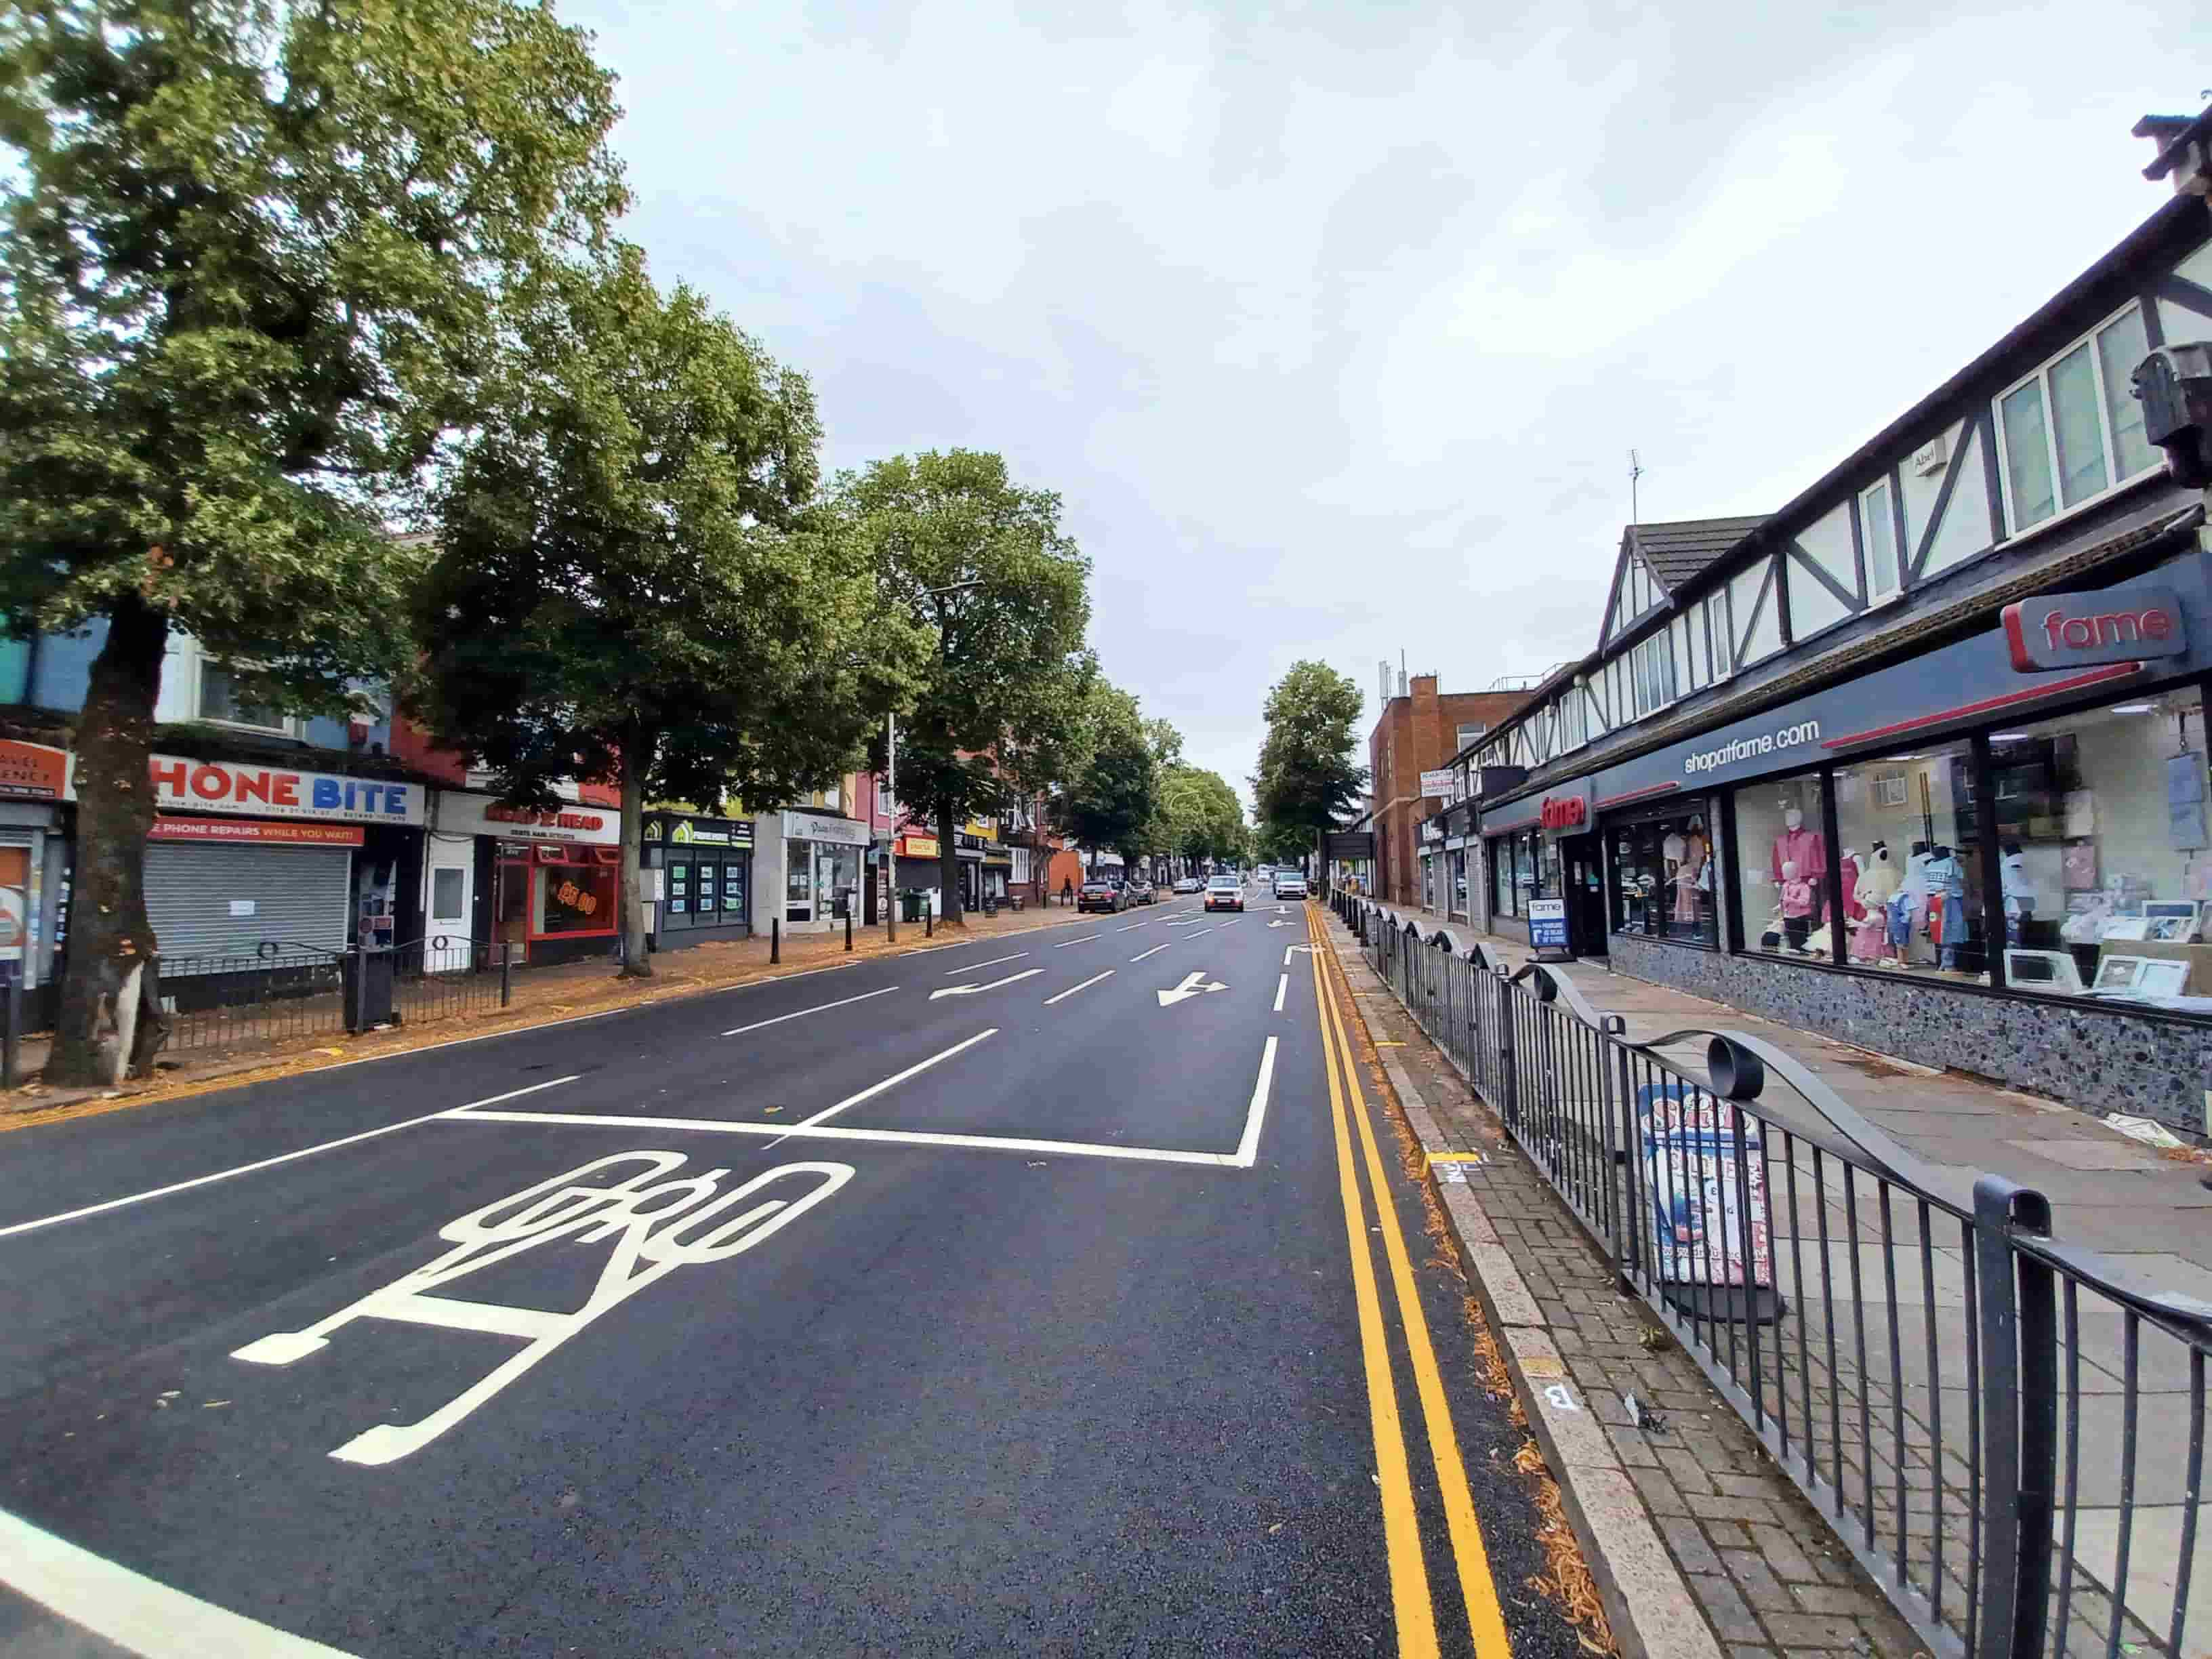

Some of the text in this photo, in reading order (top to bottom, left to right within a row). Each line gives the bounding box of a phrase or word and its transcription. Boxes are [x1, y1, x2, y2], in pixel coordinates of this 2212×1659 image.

[2039, 609, 2173, 651] fame
[1684, 720, 1820, 774] shopatfame.com
[149, 758, 300, 806] HONE
[313, 778, 407, 815] BITE
[558, 813, 605, 831] HEAD
[1540, 796, 1584, 828] fame
[163, 823, 207, 834] PHONE
[210, 825, 260, 836] REPAIRS
[262, 828, 298, 837] WHILE
[300, 829, 322, 838] YOU
[1532, 902, 1561, 912] fame
